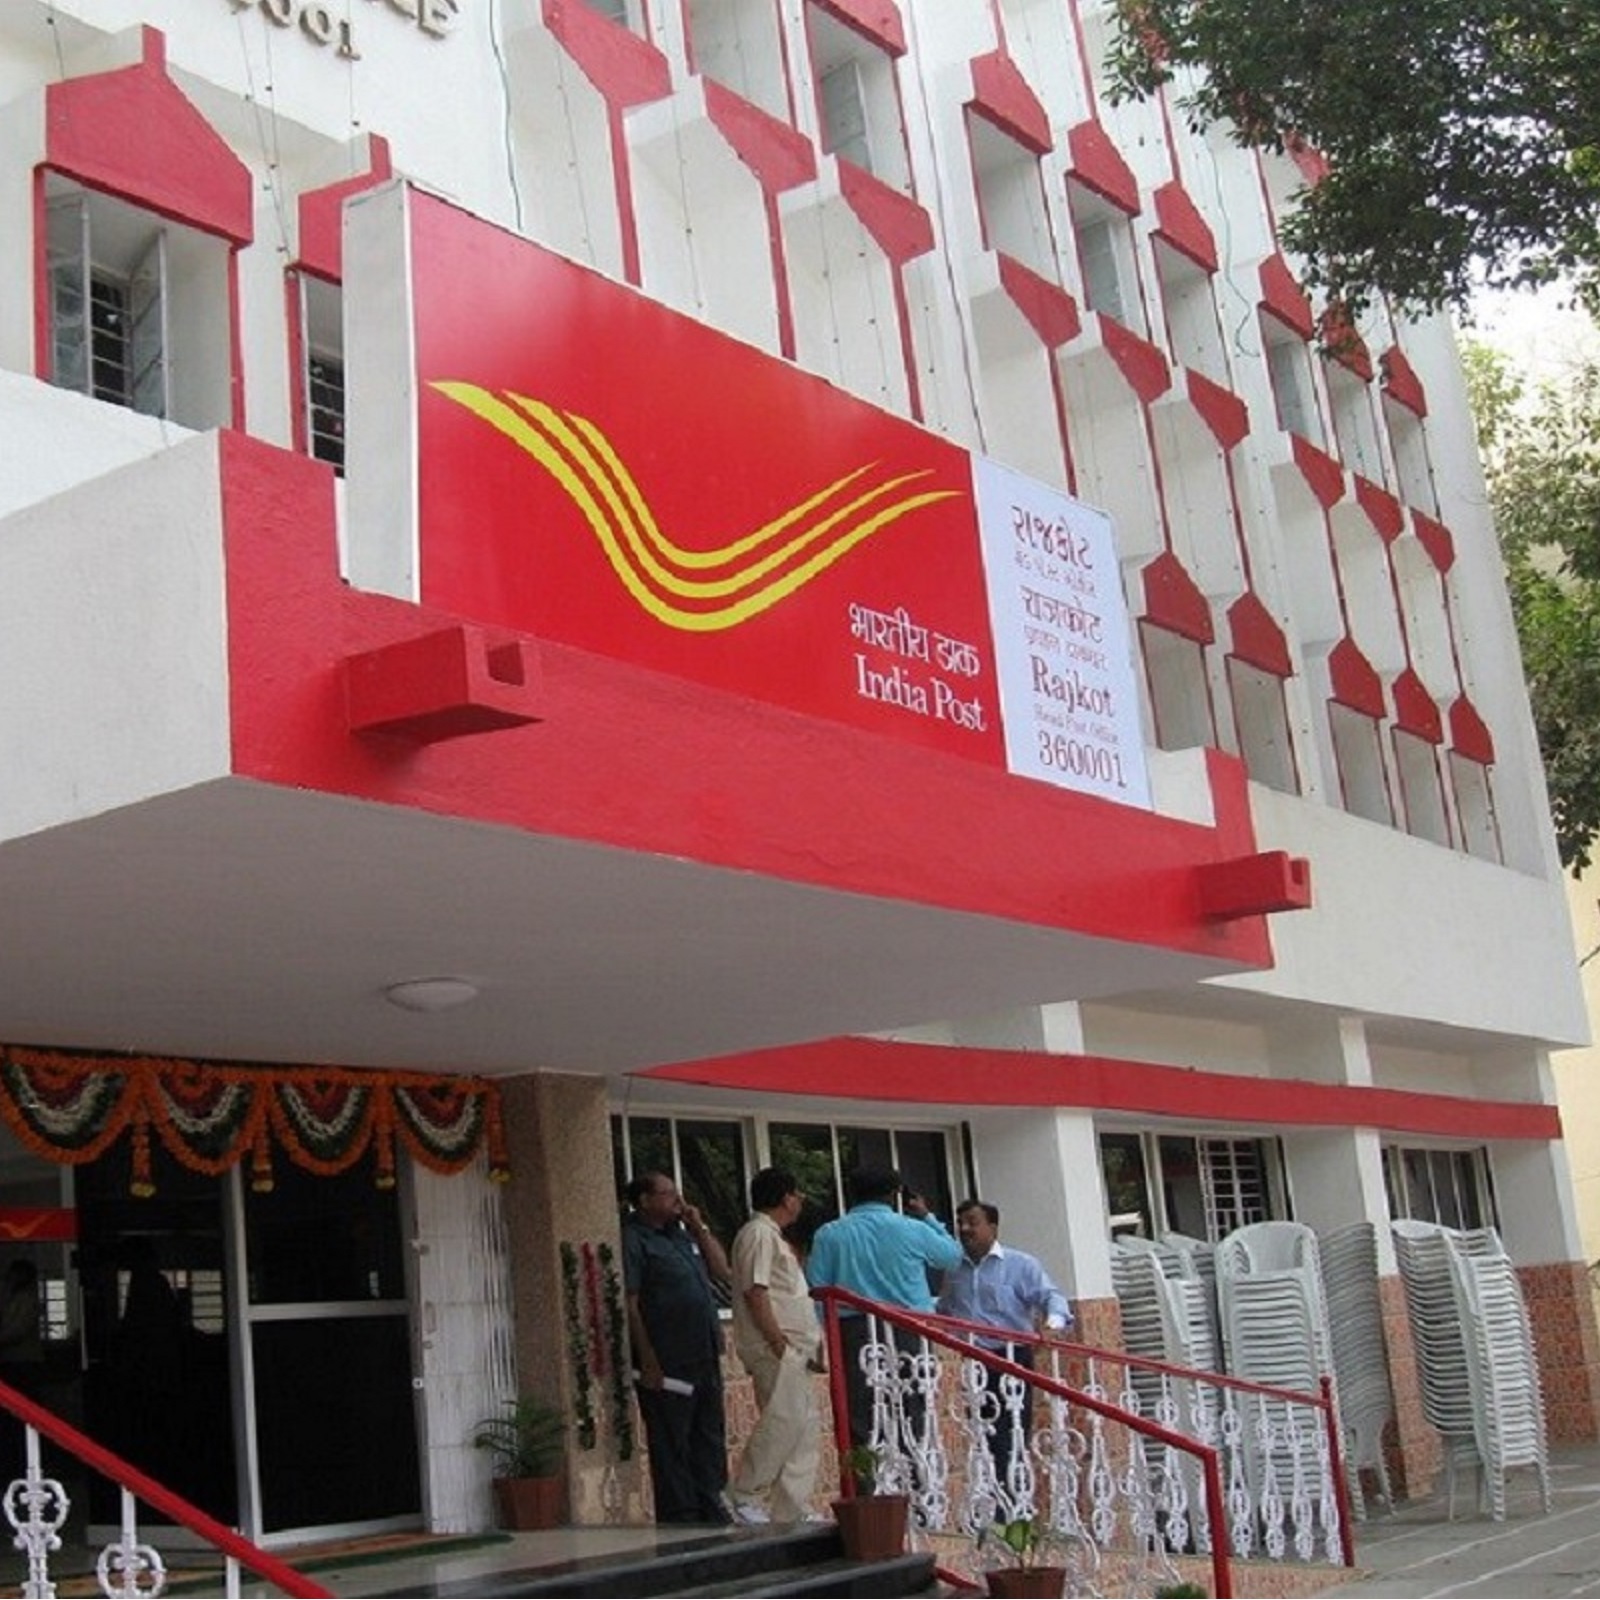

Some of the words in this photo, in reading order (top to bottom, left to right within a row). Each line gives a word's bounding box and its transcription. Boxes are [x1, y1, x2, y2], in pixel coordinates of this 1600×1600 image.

[1012, 505, 1092, 569] રાજકોટ
[849, 602, 930, 663] भारतीय
[933, 631, 980, 677] डाक
[1020, 585, 1102, 643] राजकोट
[854, 654, 929, 715] India
[930, 677, 987, 732] Post
[1031, 654, 1115, 718] Rajkot
[1038, 730, 1127, 788] 360001
